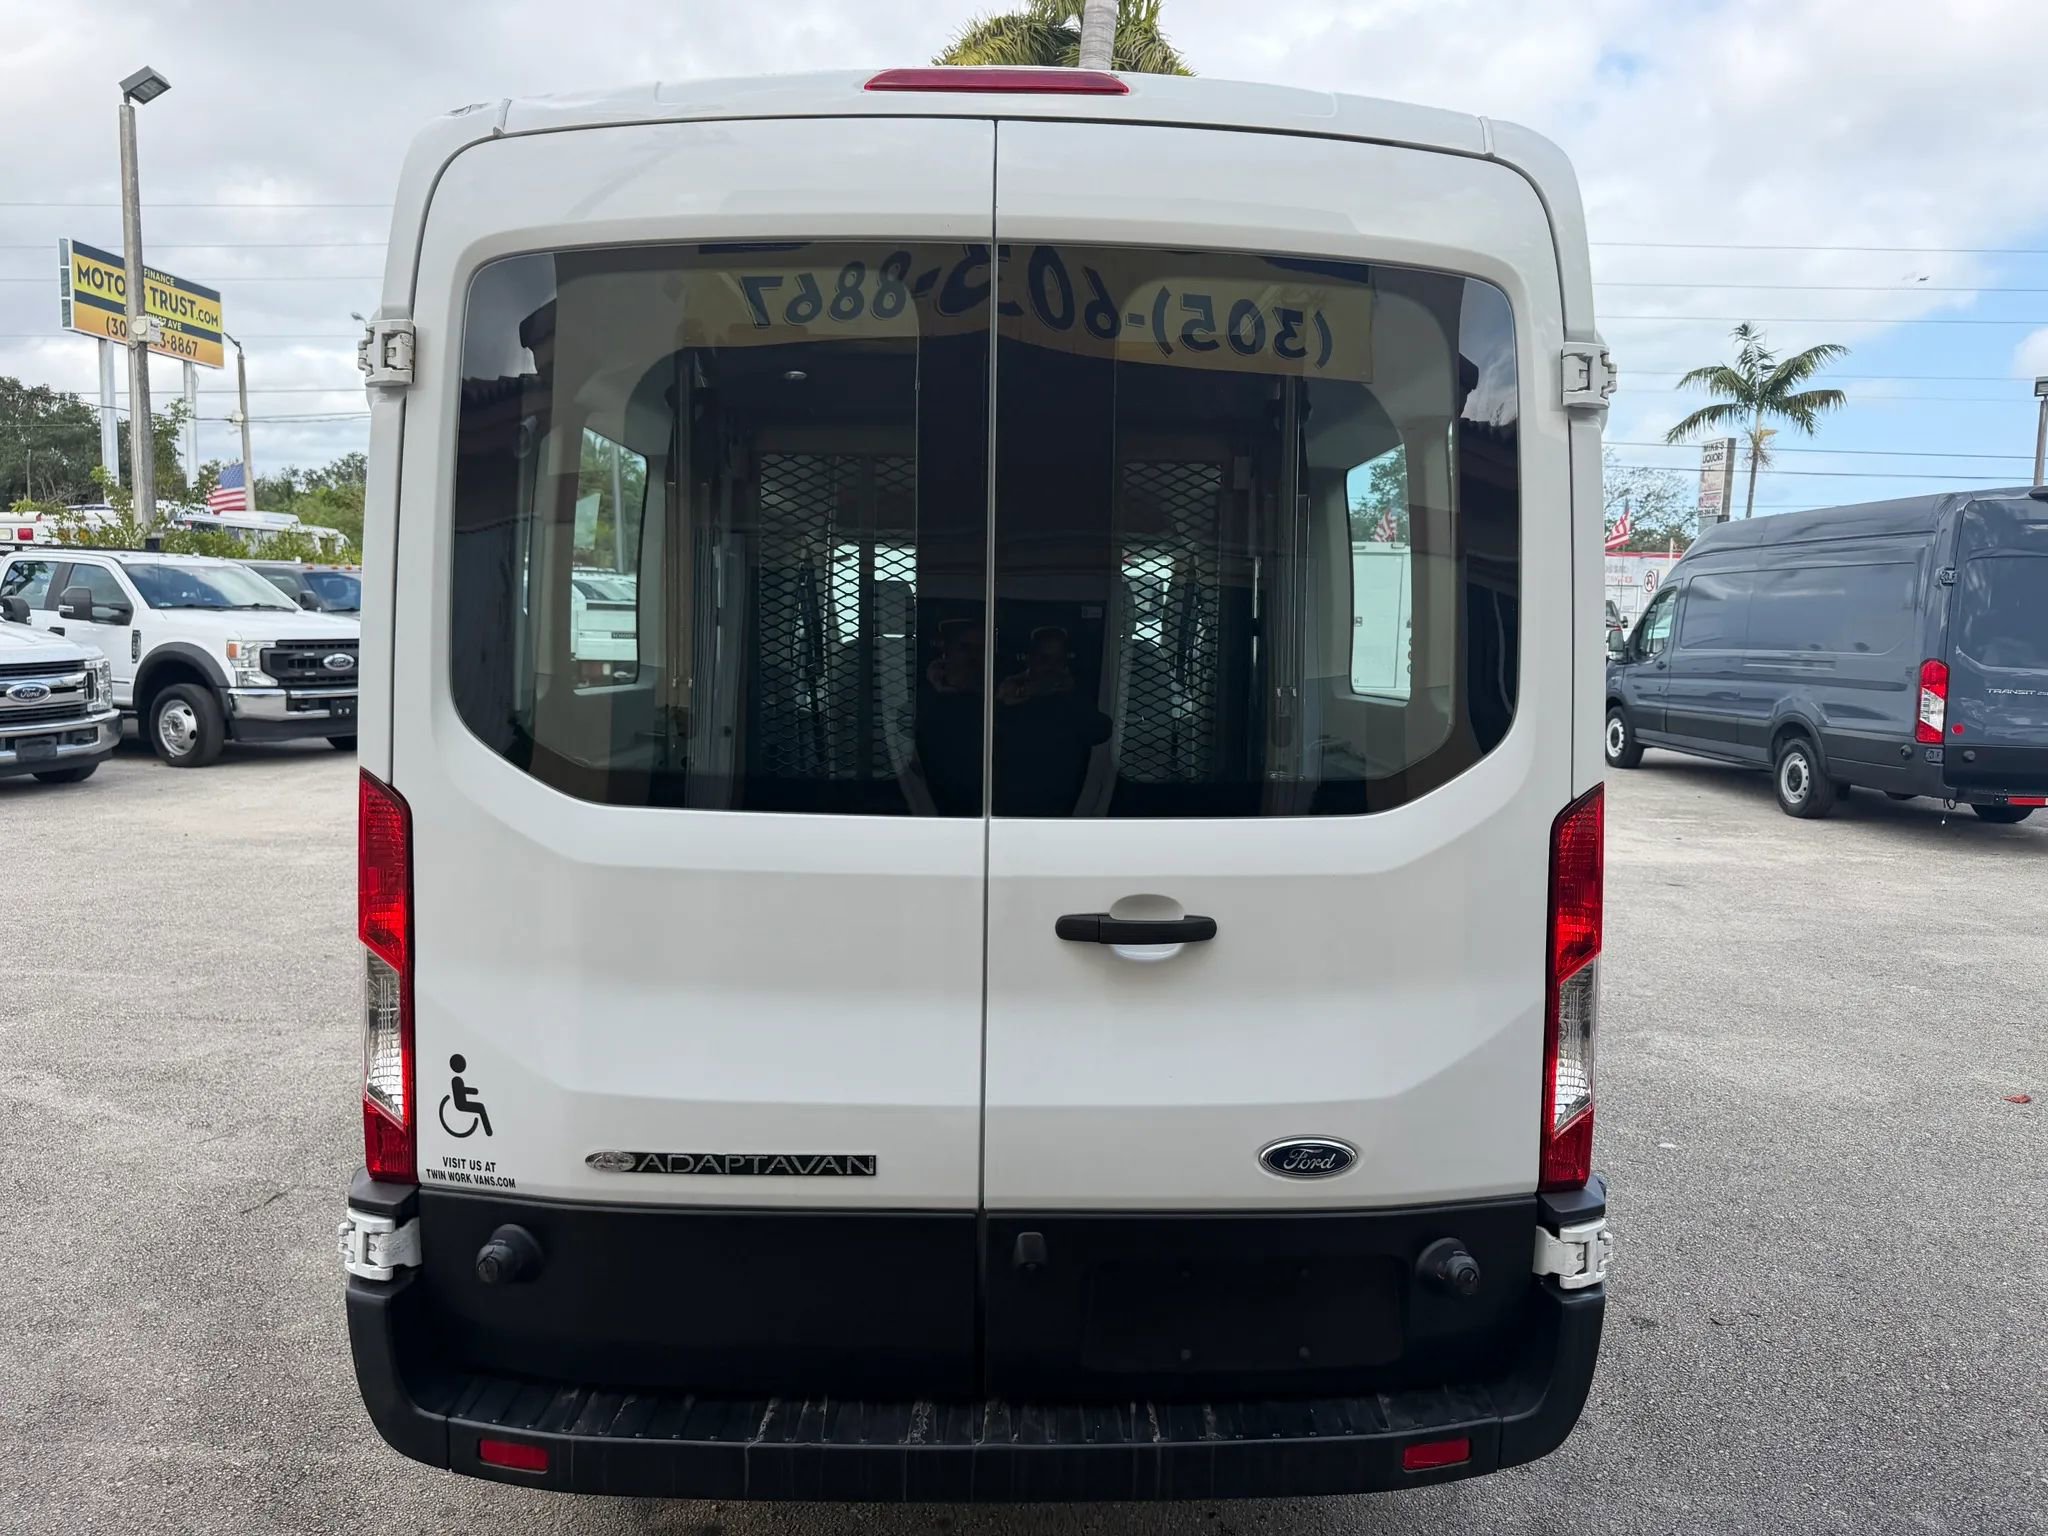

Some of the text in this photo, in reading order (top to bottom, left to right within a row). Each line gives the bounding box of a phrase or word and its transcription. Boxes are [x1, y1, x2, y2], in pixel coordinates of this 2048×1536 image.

[144, 268, 175, 287] FINANCE
[149, 286, 219, 327] TRUST.COM
[167, 319, 183, 332] AVE
[20, 687, 41, 698] Ford
[442, 1156, 497, 1173] VISIT US AT
[637, 1154, 874, 1175] ADAPTAVAN
[1283, 1148, 1337, 1170] Ford
[426, 1168, 516, 1189] TWIN WORK VANS.COM
